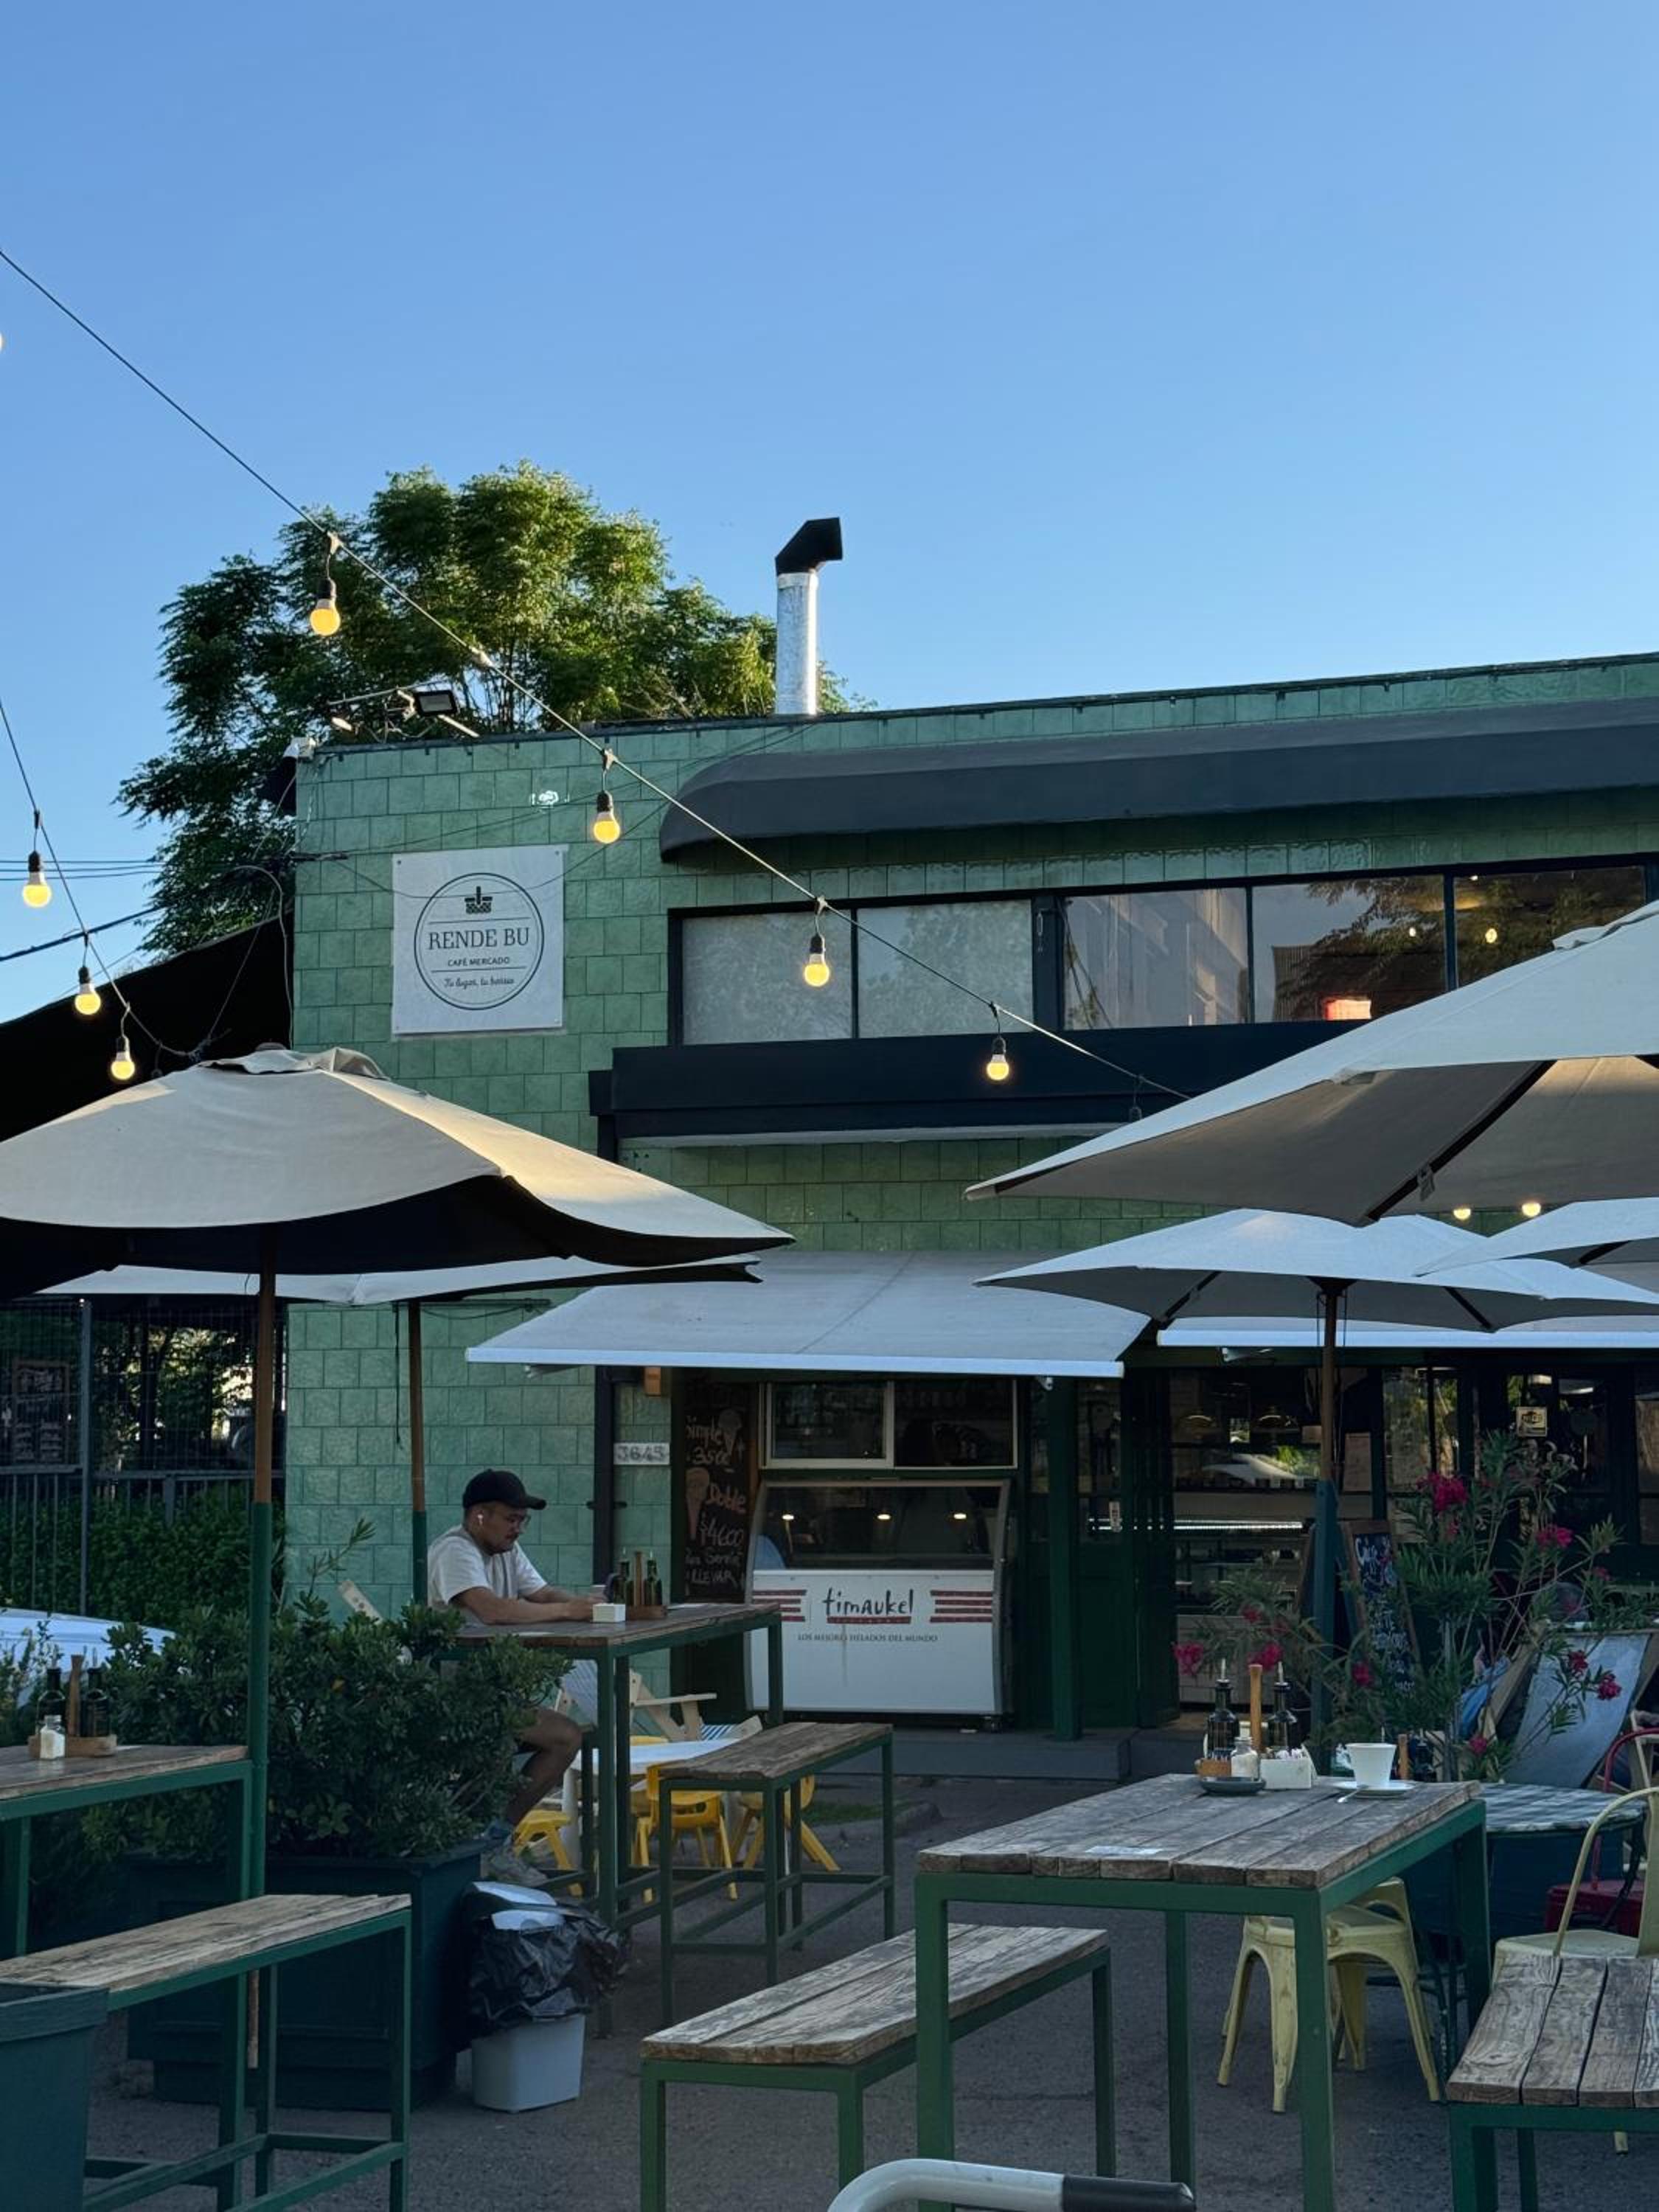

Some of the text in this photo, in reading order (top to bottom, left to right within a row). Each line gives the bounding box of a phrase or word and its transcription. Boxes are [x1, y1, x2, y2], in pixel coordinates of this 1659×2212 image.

[428, 927, 529, 950] RENDE BU
[448, 956, 510, 967] CAFÉ MERCADO
[822, 1587, 914, 1615] timaukel
